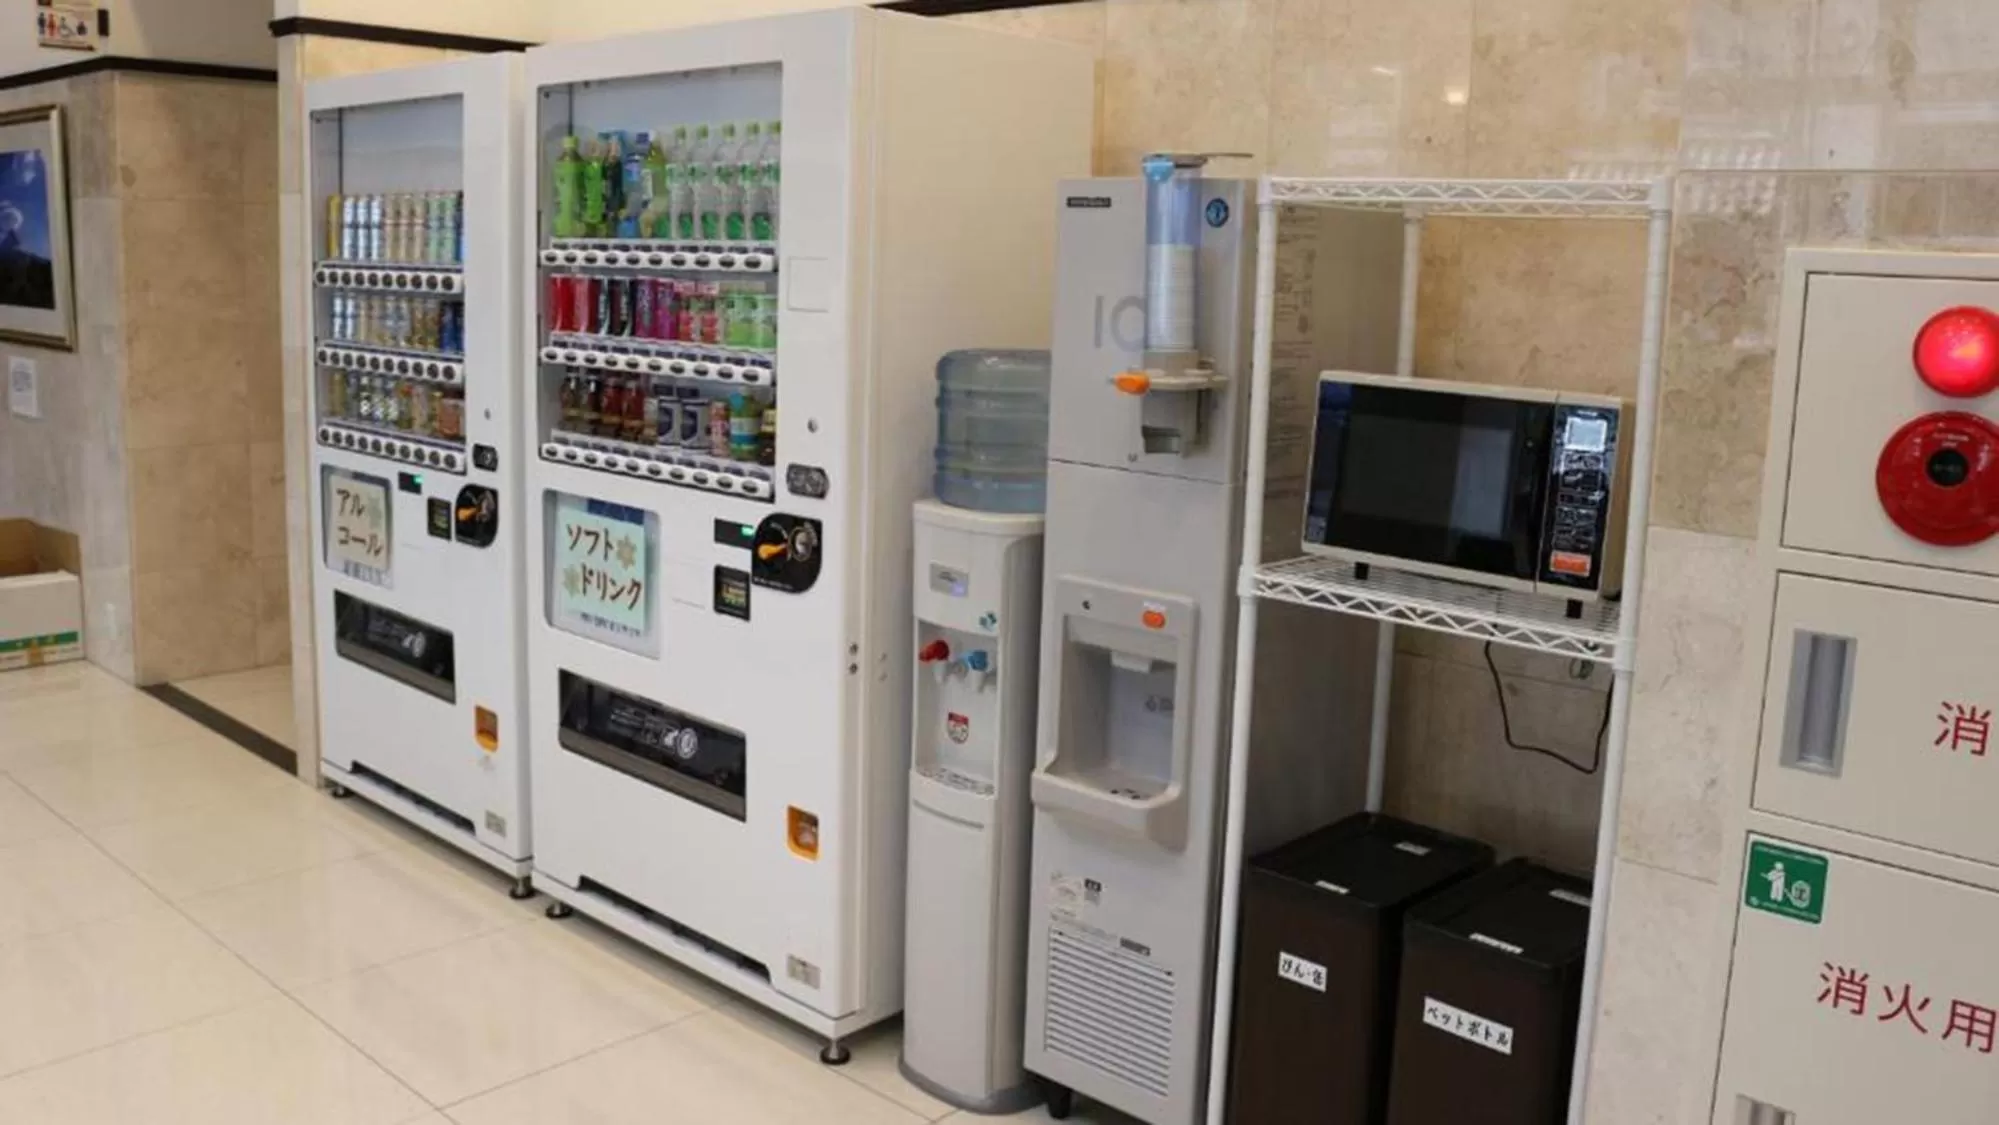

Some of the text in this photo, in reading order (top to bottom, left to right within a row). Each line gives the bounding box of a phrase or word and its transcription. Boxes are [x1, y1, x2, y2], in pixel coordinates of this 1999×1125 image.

[1094, 295, 1146, 352] IC
[336, 488, 365, 517] アル
[337, 526, 384, 557] コール
[566, 524, 614, 562] ソフト
[581, 561, 642, 611] ドリンク
[1934, 701, 1991, 756] 消
[1427, 1006, 1509, 1047] ペットボトル
[1817, 961, 1997, 1053] 消火用
